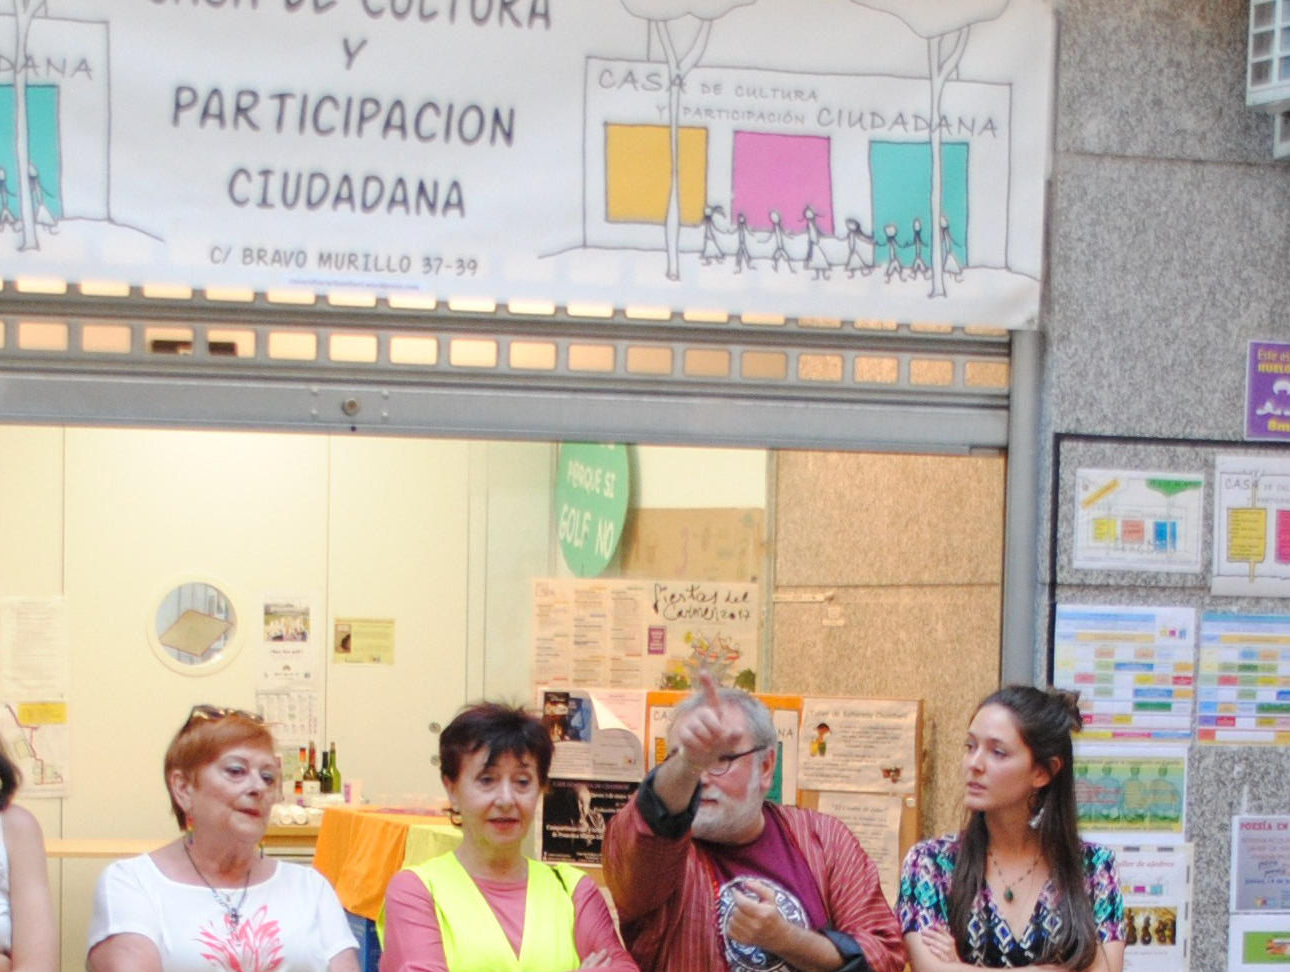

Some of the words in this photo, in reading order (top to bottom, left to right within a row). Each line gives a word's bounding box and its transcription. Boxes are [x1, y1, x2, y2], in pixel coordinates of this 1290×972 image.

[340, 38, 369, 71] Y
[598, 69, 687, 95] CASA
[702, 83, 723, 96] DE
[735, 86, 819, 102] CULTURA
[171, 85, 517, 147] PARTICIPACION
[683, 105, 806, 126] PARTICIPACIÓN
[817, 107, 999, 138] CIUDADANA
[227, 168, 467, 218] CIUDADANA
[210, 245, 232, 266] C/
[243, 247, 307, 269] BRAVO
[317, 252, 411, 275] MURILLO
[421, 256, 479, 278] 37-39
[560, 502, 591, 548] GOLF
[595, 518, 615, 560] NO
[1240, 819, 1272, 831] POESÍA
[1277, 822, 1288, 831] EN
